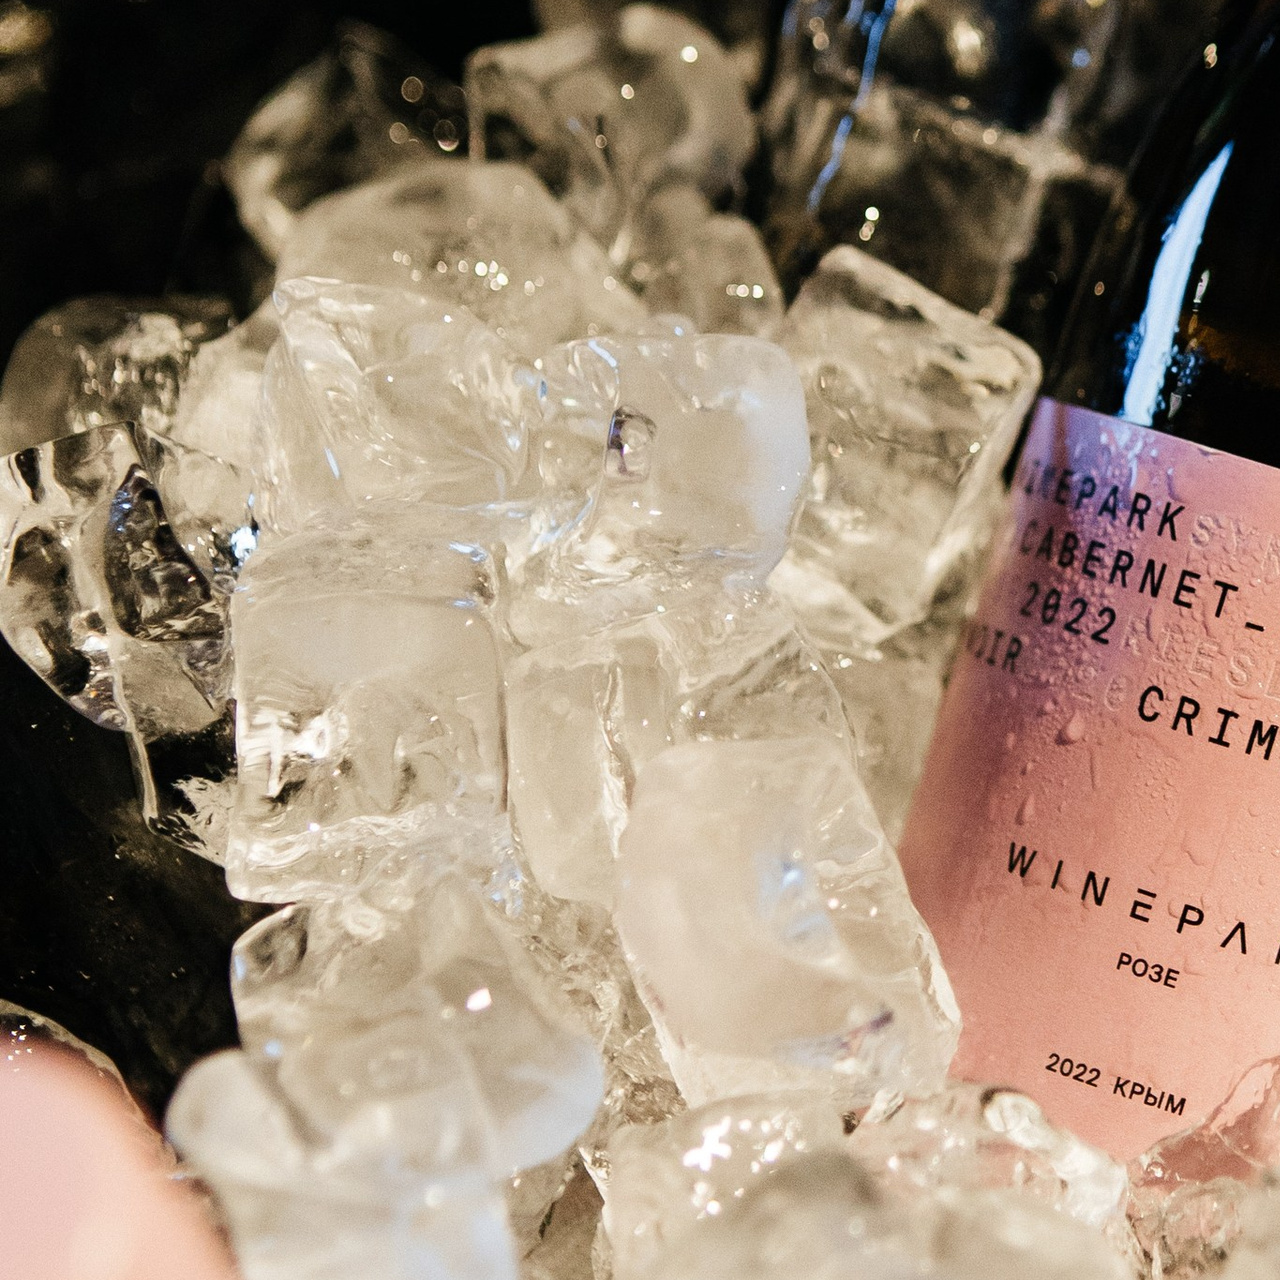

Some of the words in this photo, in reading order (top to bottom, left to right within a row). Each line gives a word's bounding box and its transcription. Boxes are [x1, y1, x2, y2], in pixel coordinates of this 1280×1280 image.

[1020, 581, 1117, 645] 2022
[1116, 952, 1181, 989] РОЗЕ
[1045, 1052, 1102, 1087] 2022
[1113, 1076, 1187, 1116] КРЫМ
